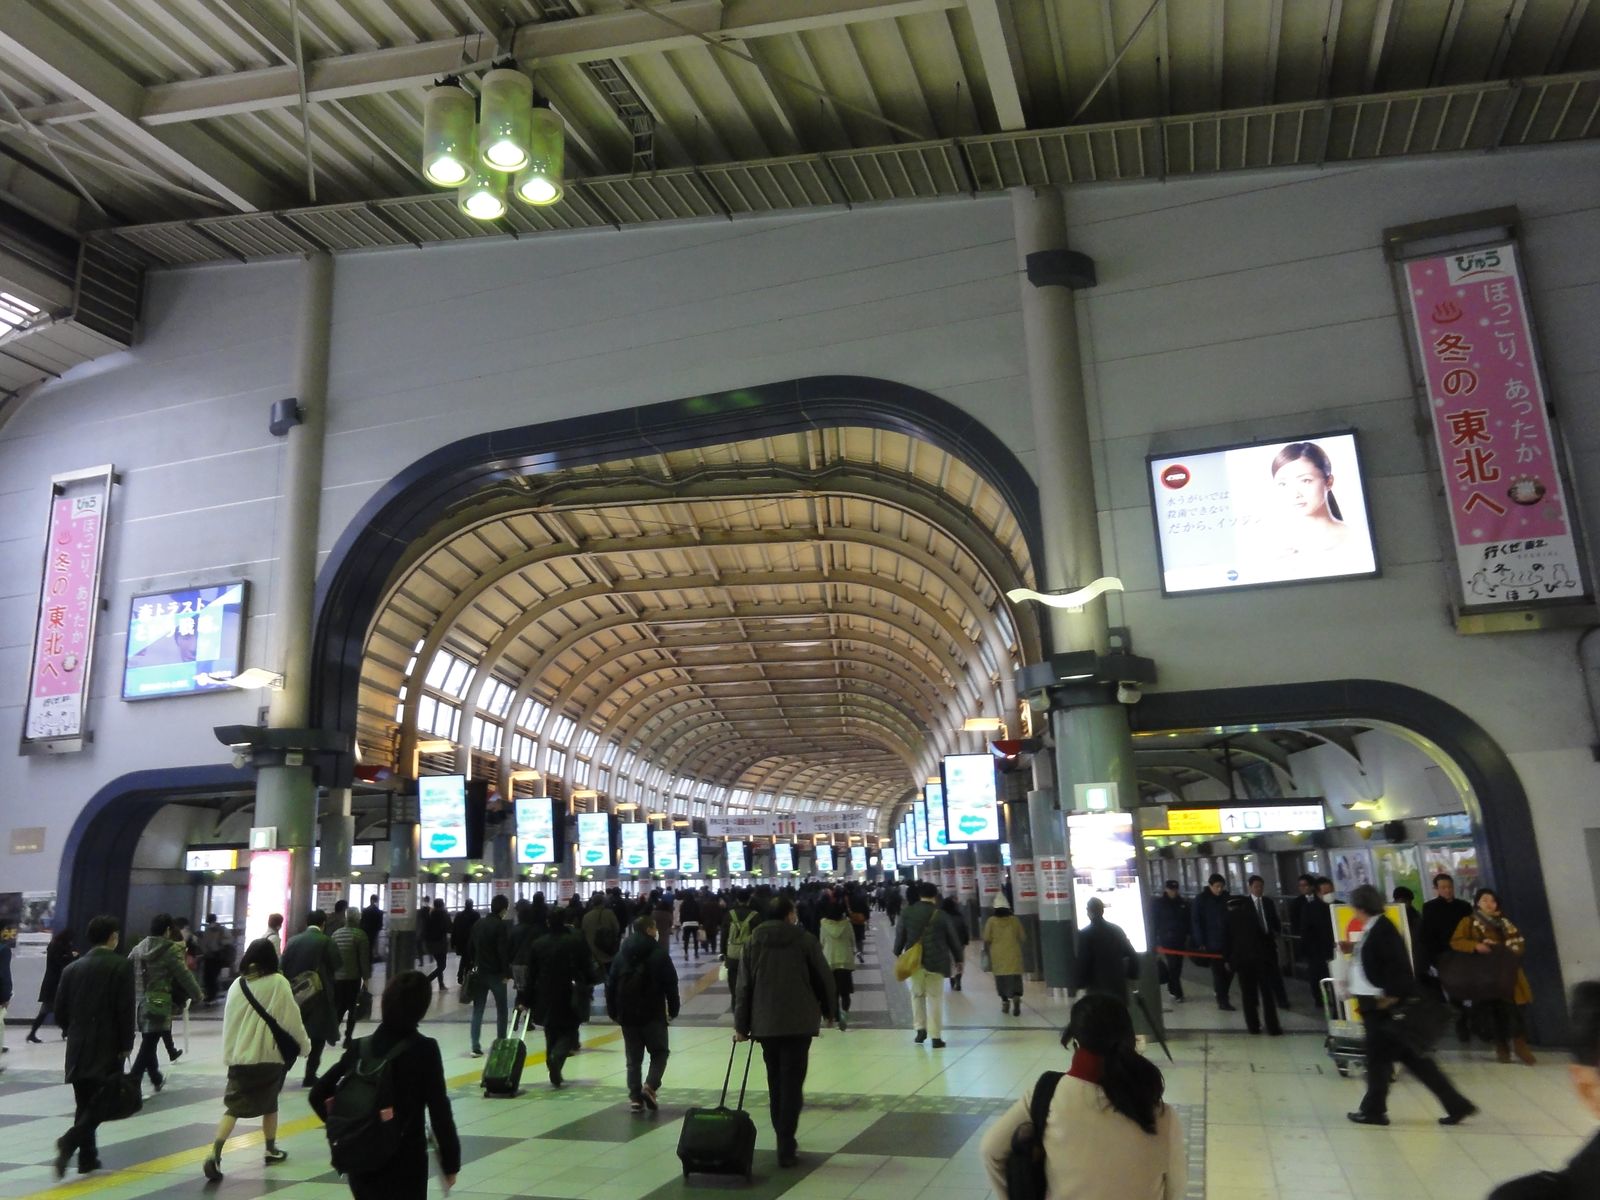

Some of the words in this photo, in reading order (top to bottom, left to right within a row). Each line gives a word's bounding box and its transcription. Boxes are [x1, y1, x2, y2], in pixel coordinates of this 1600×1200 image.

[1455, 250, 1501, 272] びゅう
[1434, 332, 1506, 515] 冬の東北へ
